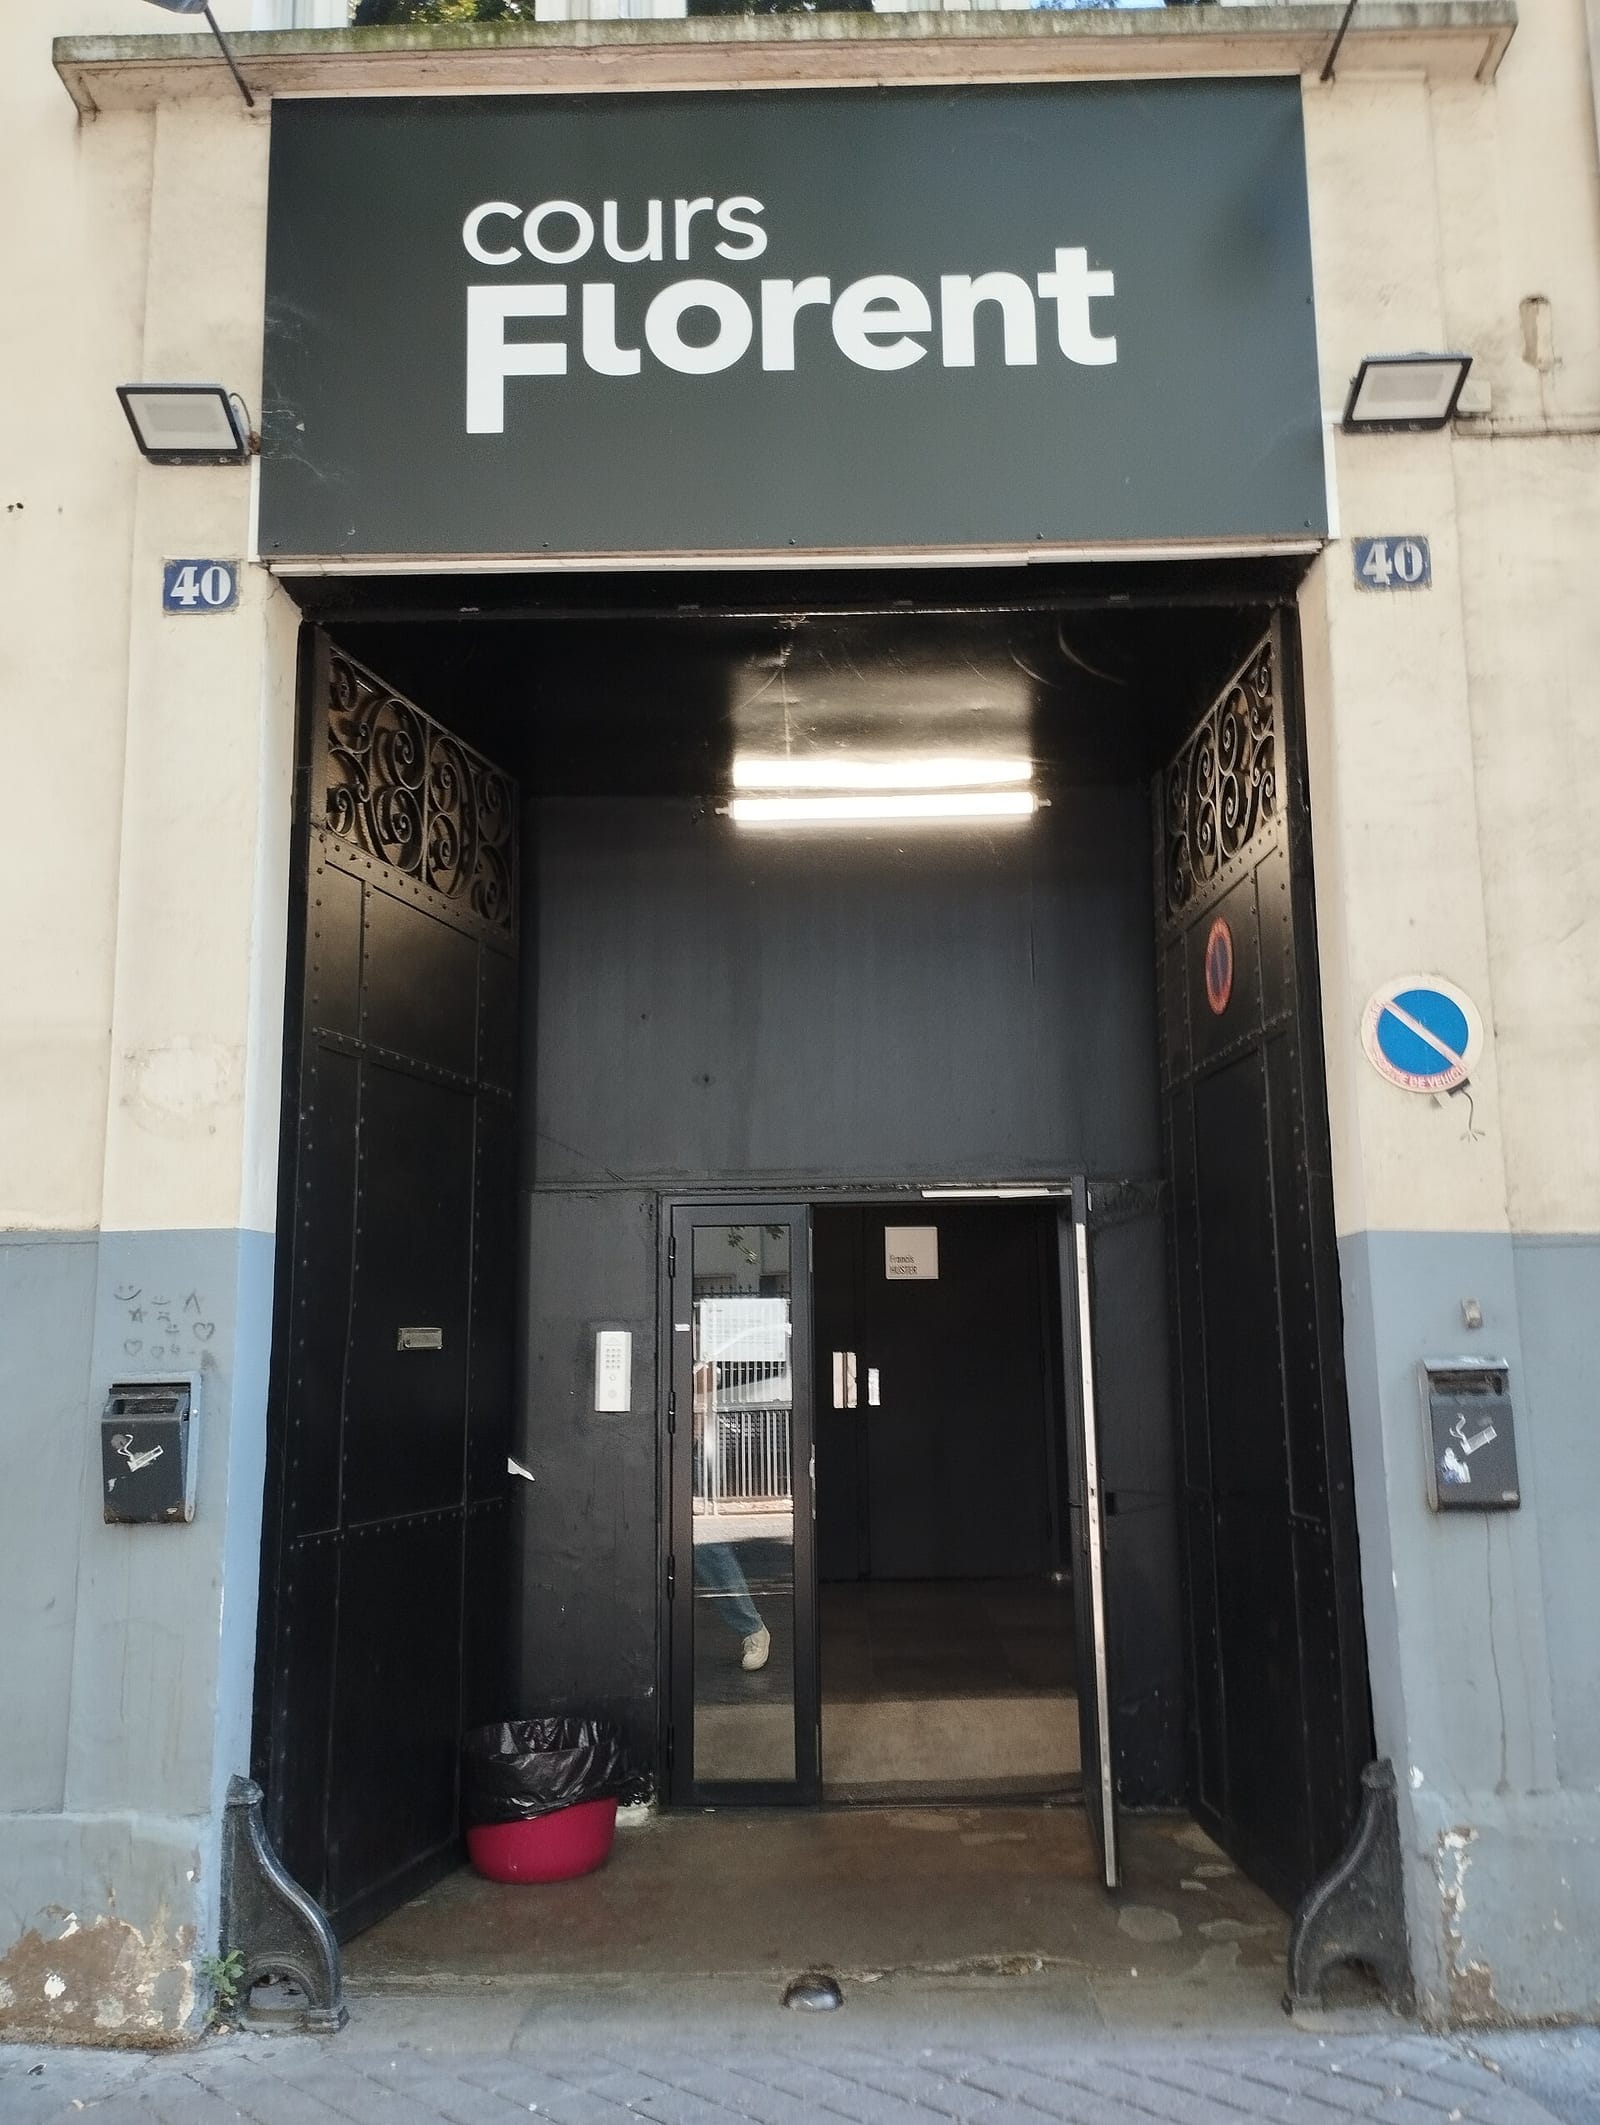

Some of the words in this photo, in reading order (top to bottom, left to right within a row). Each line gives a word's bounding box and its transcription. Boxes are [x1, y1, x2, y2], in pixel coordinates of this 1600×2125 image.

[463, 196, 768, 266] cours
[467, 247, 1118, 434] Florent
[170, 566, 231, 606] 40
[1363, 541, 1423, 585] 40
